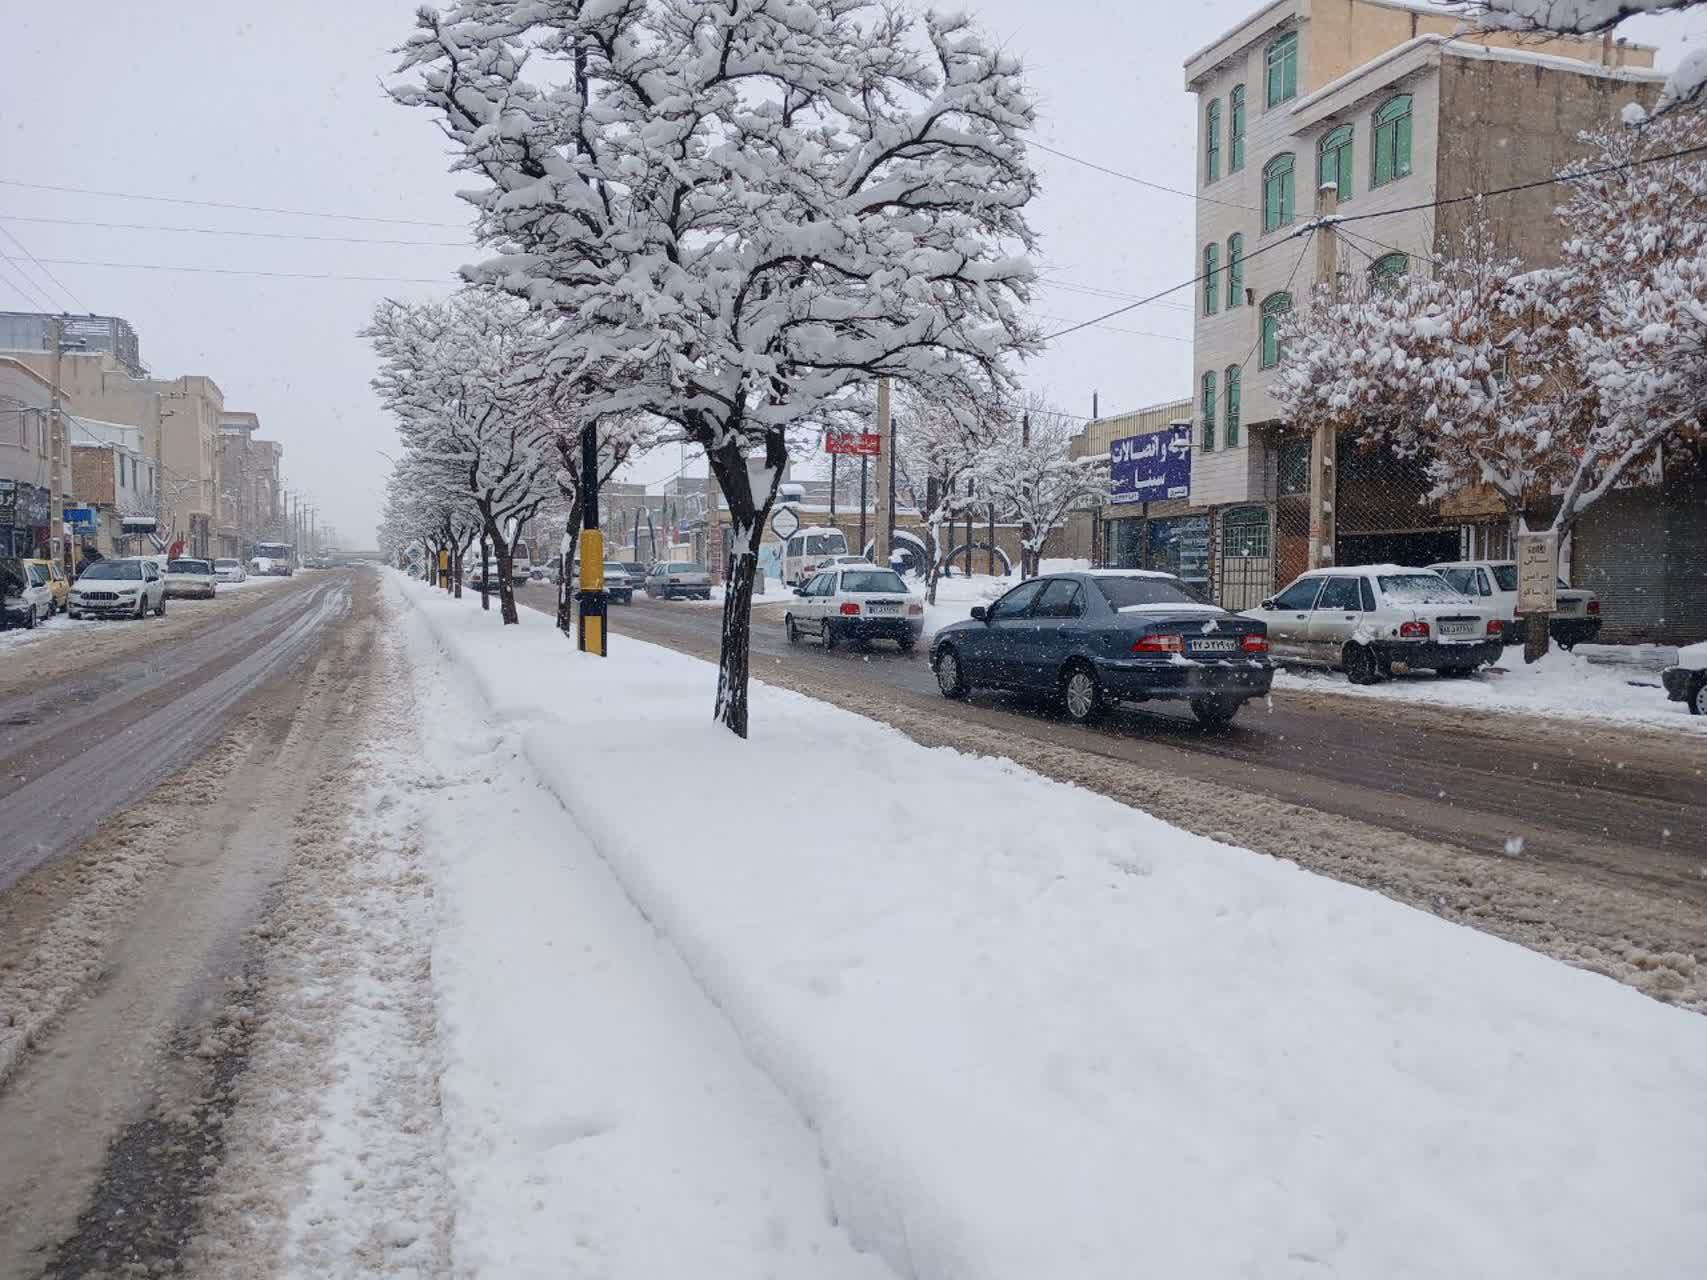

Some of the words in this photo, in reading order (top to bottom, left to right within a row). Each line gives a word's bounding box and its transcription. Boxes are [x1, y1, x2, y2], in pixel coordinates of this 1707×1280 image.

[1111, 434, 1159, 464] اتصالات
[1160, 443, 1167, 462] و
[1134, 468, 1167, 492] سینا
